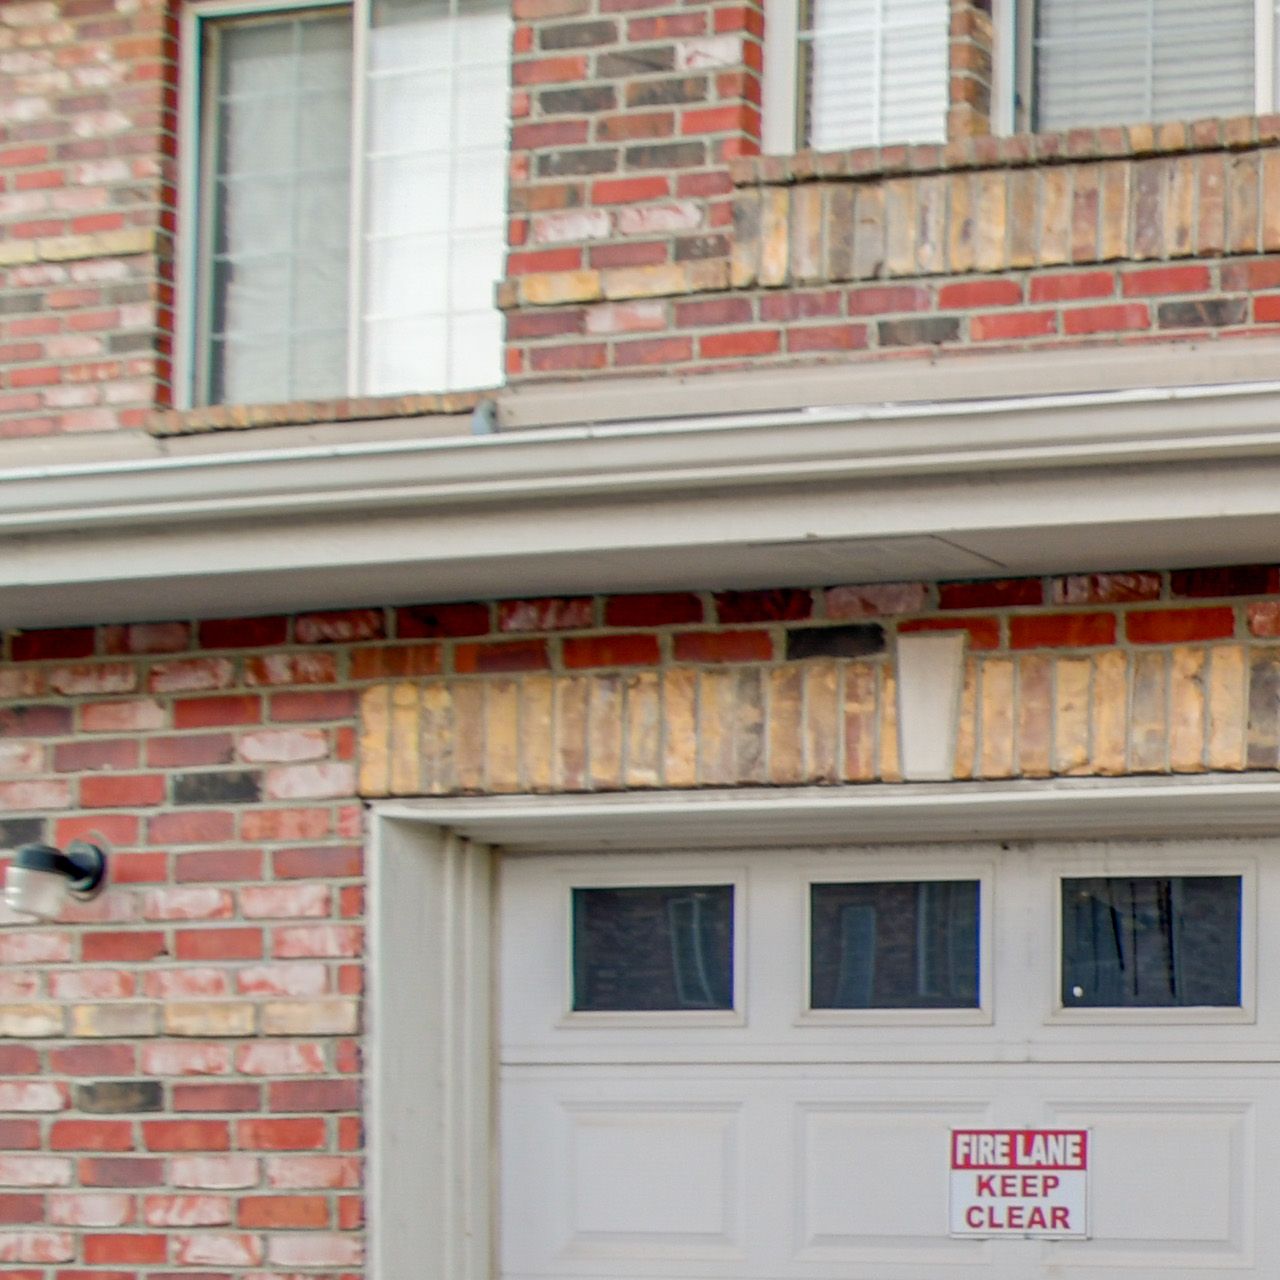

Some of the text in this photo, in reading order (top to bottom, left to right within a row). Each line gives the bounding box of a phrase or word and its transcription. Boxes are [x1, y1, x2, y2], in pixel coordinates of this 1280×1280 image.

[955, 1133, 1082, 1166] FIRE LANE
[976, 1175, 1060, 1198] KEEP
[965, 1205, 1071, 1229] CLEAR
